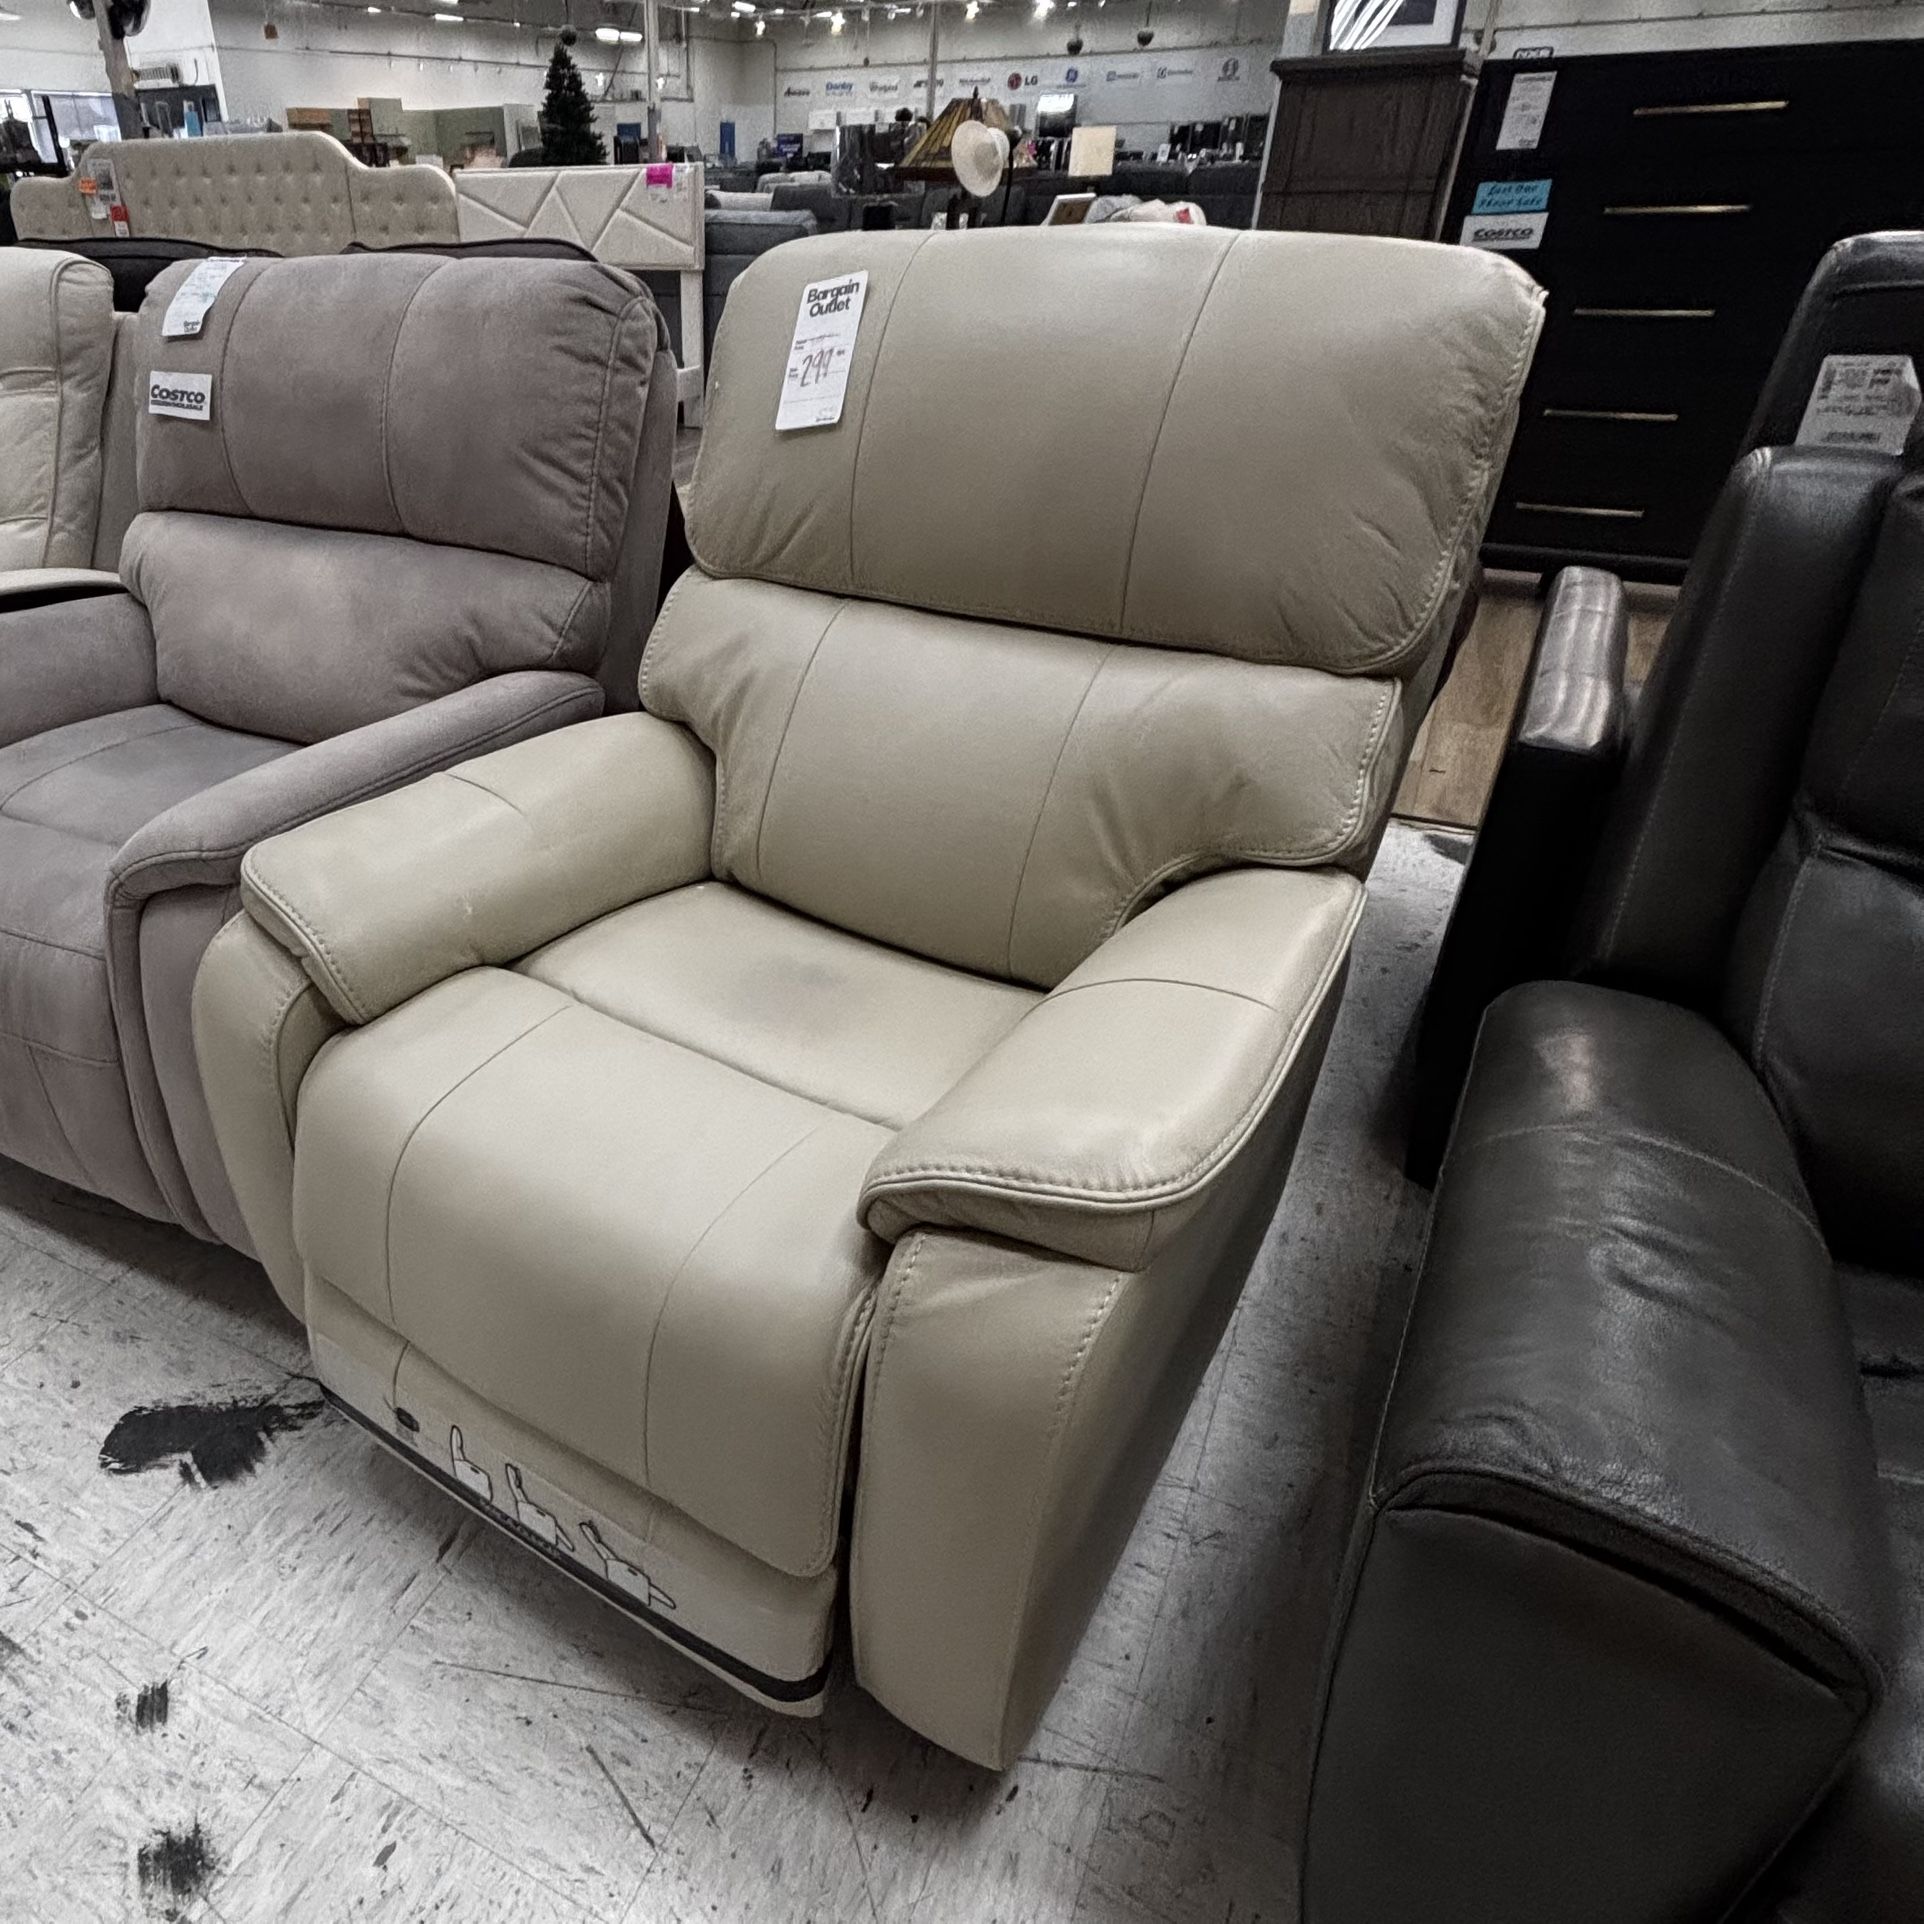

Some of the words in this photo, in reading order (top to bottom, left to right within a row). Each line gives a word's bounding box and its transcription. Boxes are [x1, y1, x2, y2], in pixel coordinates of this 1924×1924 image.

[1024, 75, 1038, 86] LG
[806, 278, 859, 305] Bargain
[809, 297, 851, 318] Outlet
[800, 346, 834, 388] 299
[151, 384, 206, 404] COSTCO
